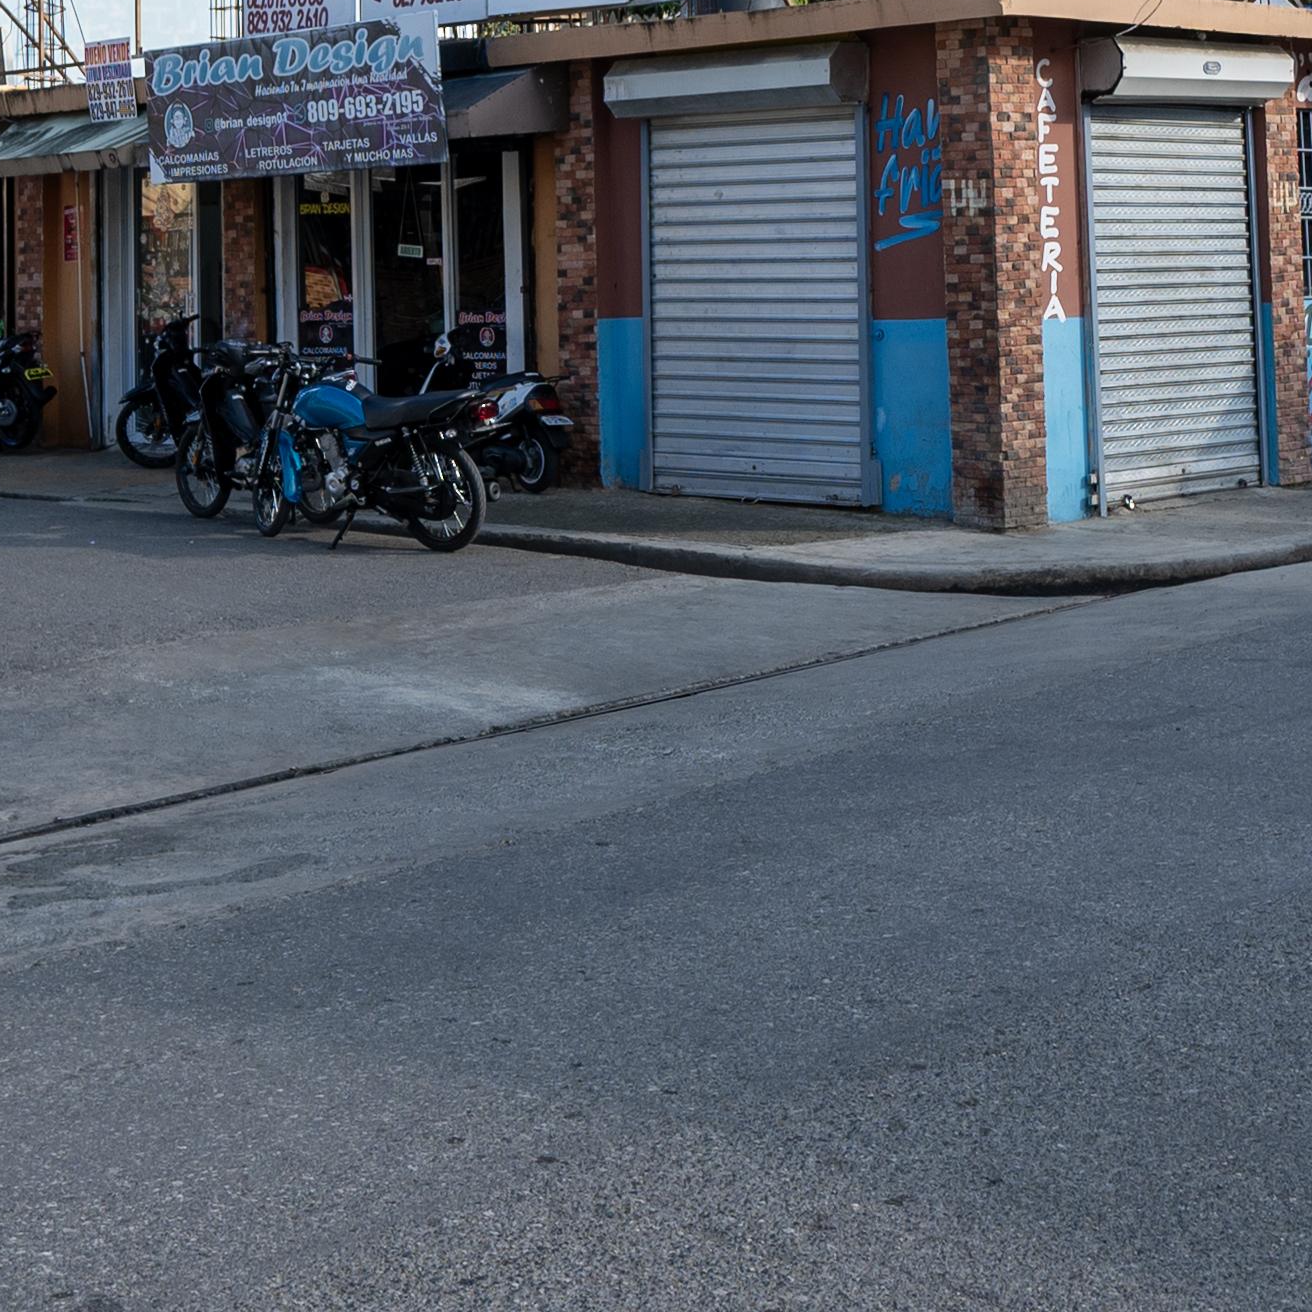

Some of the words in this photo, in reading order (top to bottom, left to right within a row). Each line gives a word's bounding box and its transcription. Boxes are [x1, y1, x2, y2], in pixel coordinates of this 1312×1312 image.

[108, 42, 129, 62] VENDE
[152, 49, 263, 96] Brian
[273, 28, 424, 77] Design
[88, 79, 133, 101] 829-932-2610
[255, 83, 289, 97] Haciendo
[306, 89, 424, 123] 809-693-2195
[323, 138, 370, 152] TARJETAS
[399, 132, 438, 145] VALLAS
[245, 145, 293, 159] LETREROS
[354, 150, 390, 163] MUCHO
[170, 164, 228, 177] IMPRESIONES
[1035, 58, 1067, 323] CAFETERIA
[323, 202, 350, 214] DESIGN
